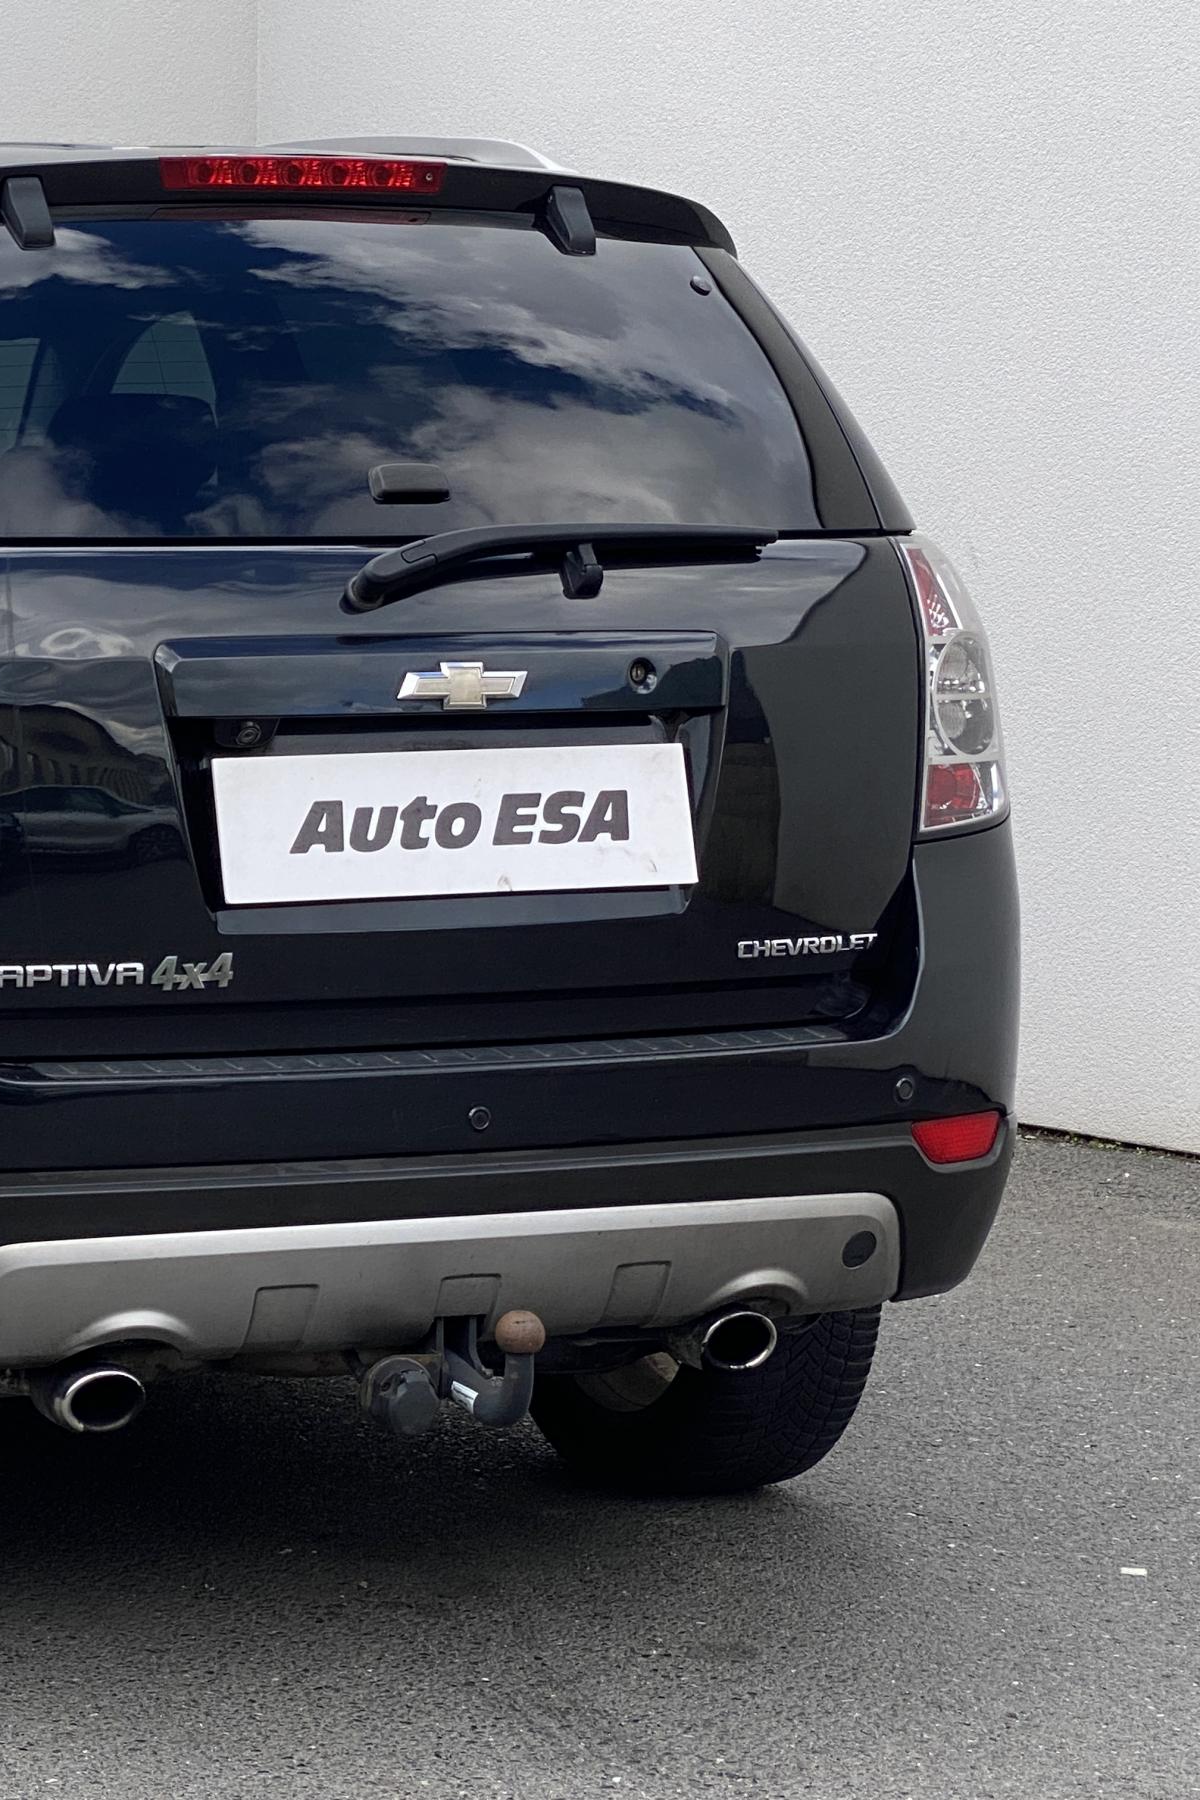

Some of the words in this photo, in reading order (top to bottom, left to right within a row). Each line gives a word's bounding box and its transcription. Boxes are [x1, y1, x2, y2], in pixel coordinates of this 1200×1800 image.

[289, 795, 482, 855] Auto
[492, 789, 630, 846] ESA
[737, 933, 878, 958] CHEVROLET
[150, 952, 234, 991] 4x4
